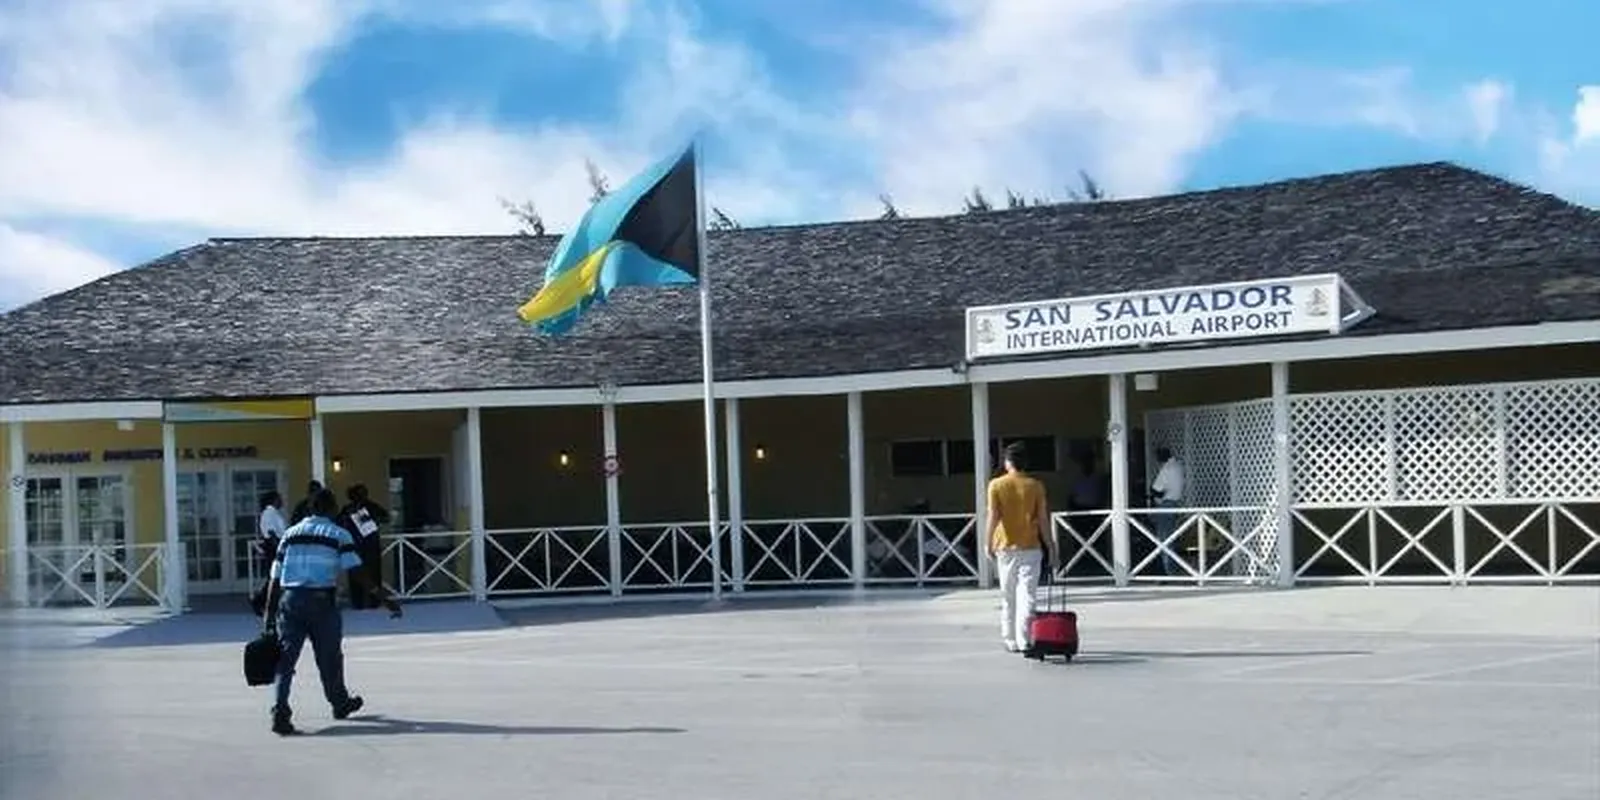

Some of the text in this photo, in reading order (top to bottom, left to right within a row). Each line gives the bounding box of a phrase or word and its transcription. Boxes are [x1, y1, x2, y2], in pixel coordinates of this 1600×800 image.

[1005, 285, 1294, 330] SAN SALVADOR
[1007, 311, 1293, 349] INTERNATIONAL AIRPORT
